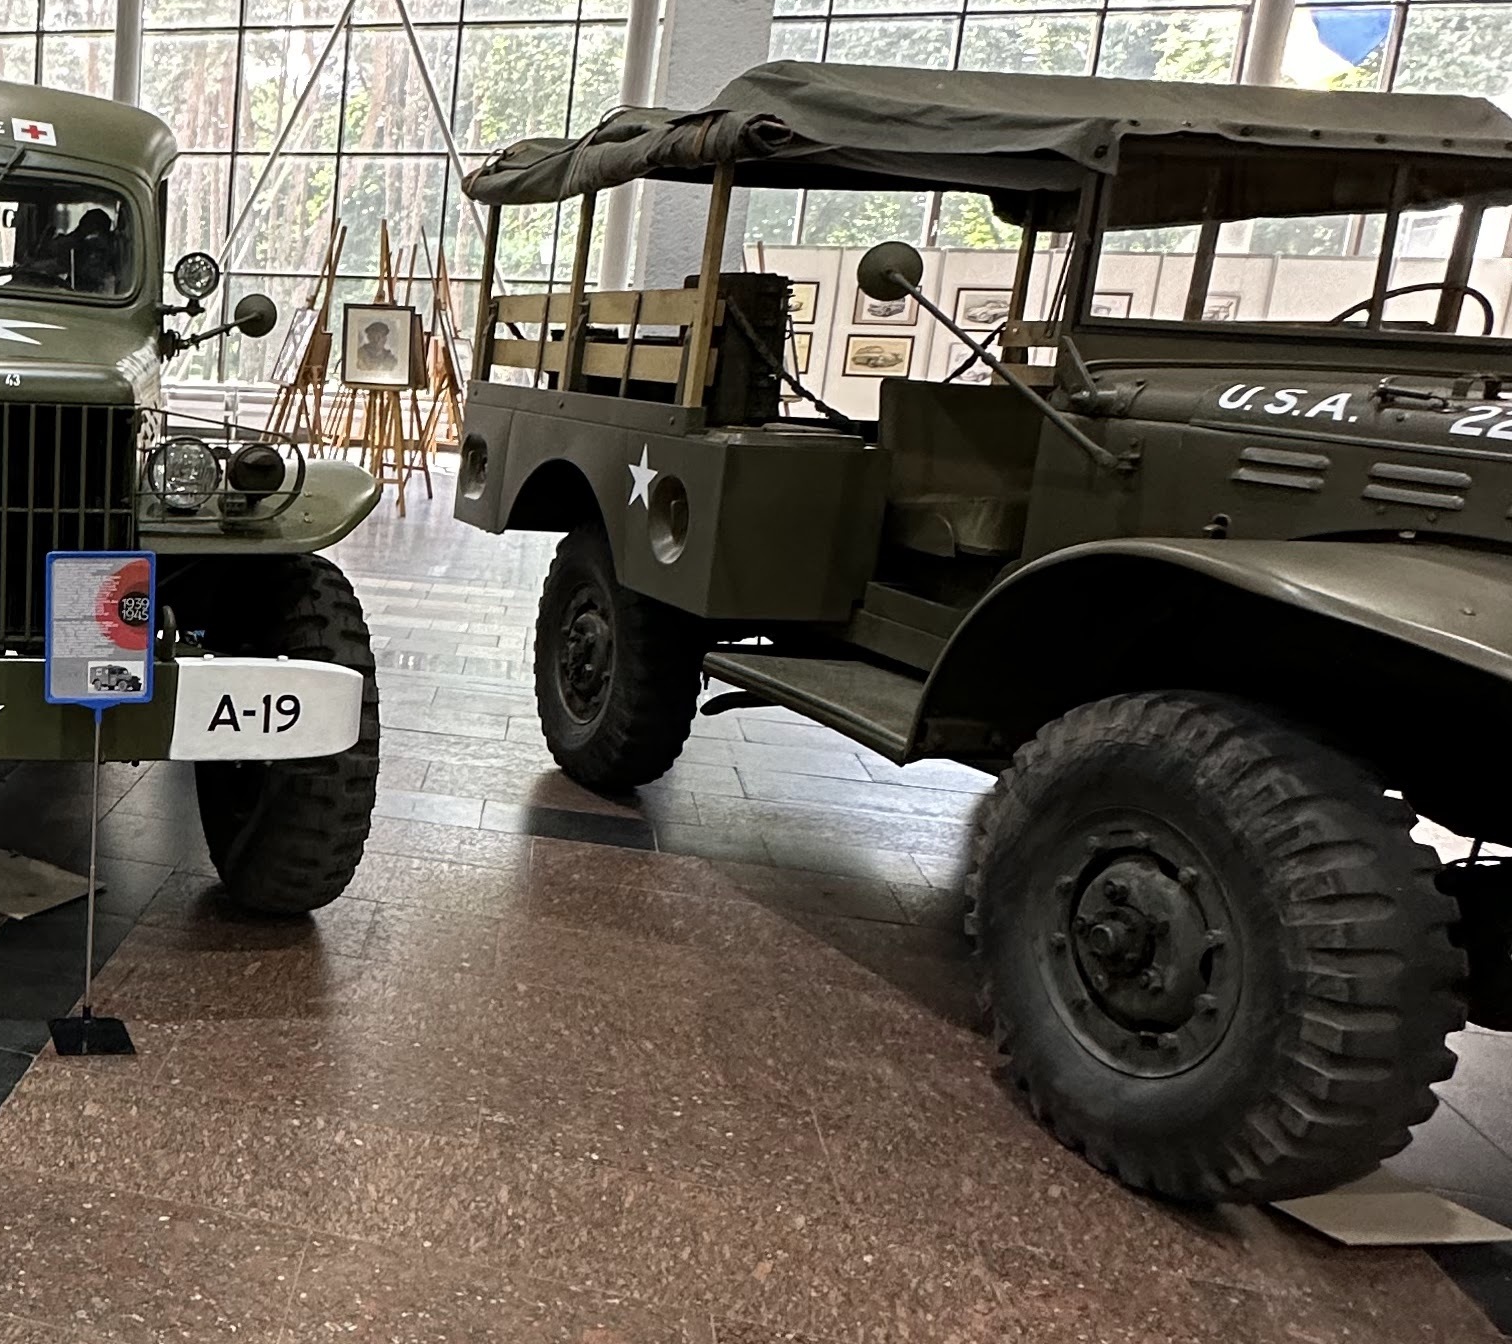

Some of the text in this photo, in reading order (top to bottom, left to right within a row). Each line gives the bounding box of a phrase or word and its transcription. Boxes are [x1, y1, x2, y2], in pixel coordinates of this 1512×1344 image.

[5, 373, 21, 387] 43
[1218, 384, 1358, 423] U.S.A.
[121, 597, 150, 610] 1939
[121, 609, 149, 621] 1945
[207, 694, 301, 734] A-19
